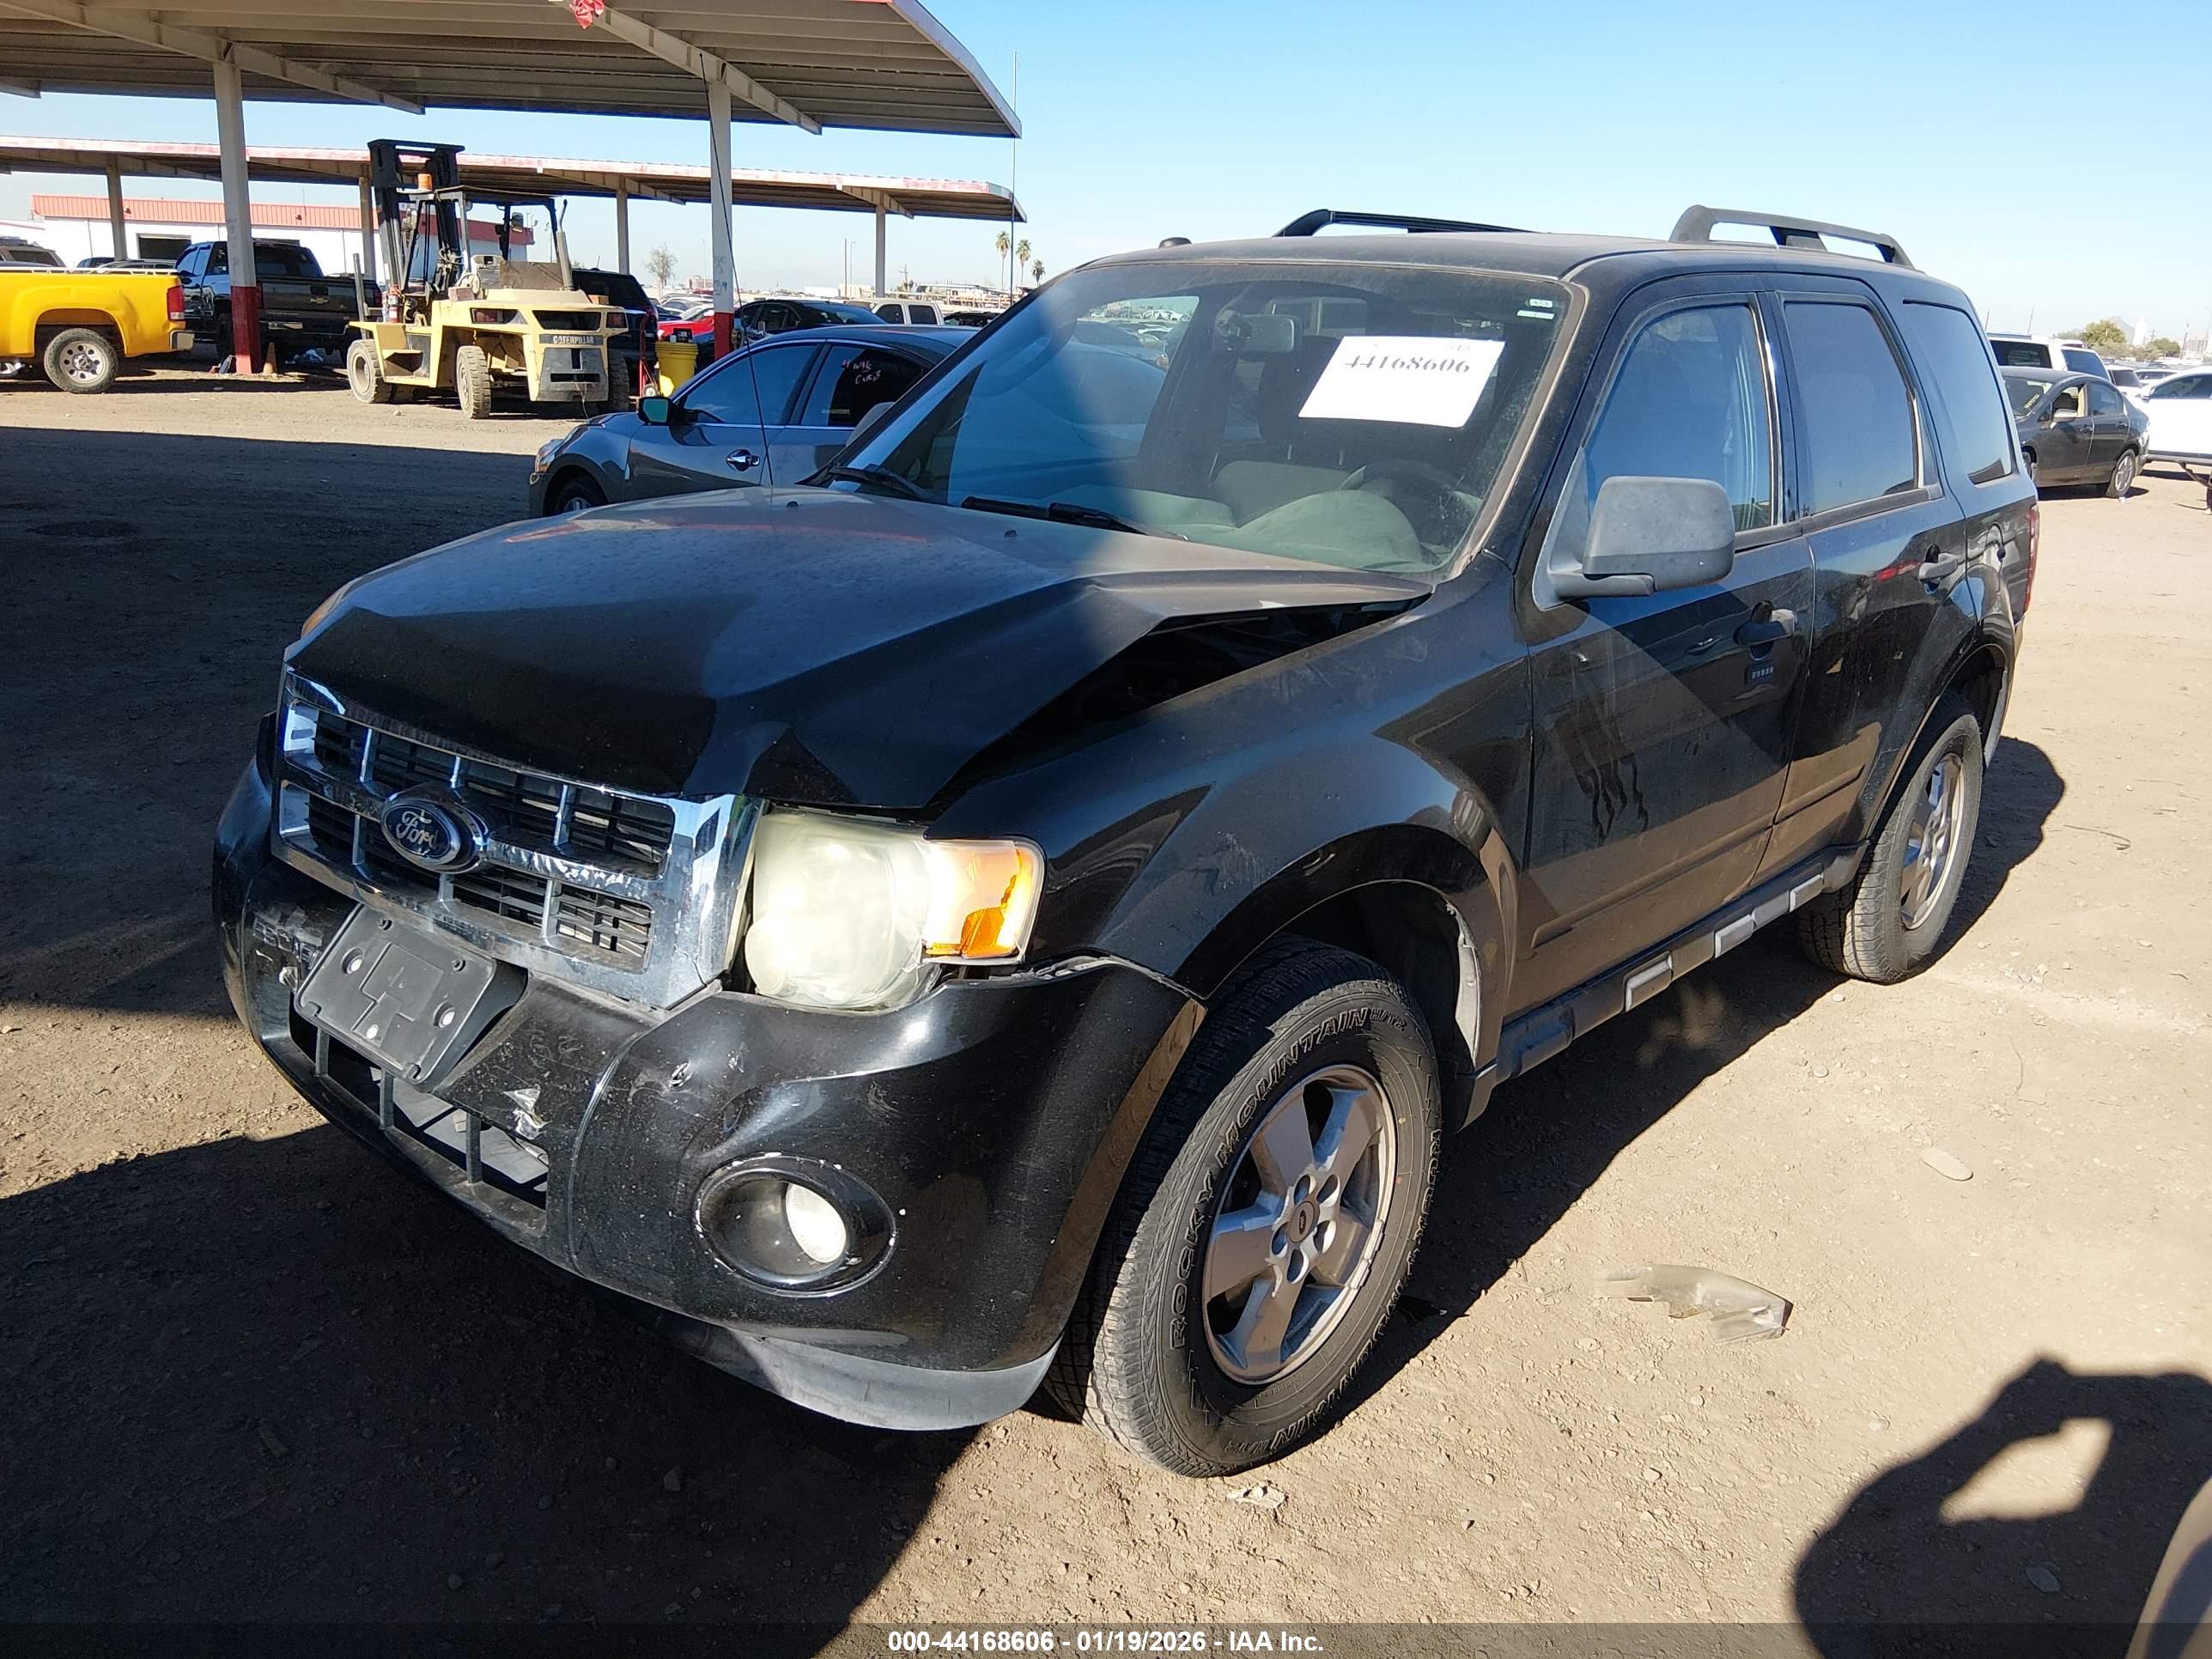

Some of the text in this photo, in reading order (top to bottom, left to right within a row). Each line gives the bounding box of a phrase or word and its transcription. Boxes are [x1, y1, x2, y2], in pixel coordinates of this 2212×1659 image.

[552, 335, 594, 344] CATERPILLAR
[1345, 355, 1470, 373] 44168606
[396, 811, 440, 850] Ford
[1170, 1170, 1213, 1350] ROCKY
[1214, 1006, 1369, 1169] MOUNTAIN
